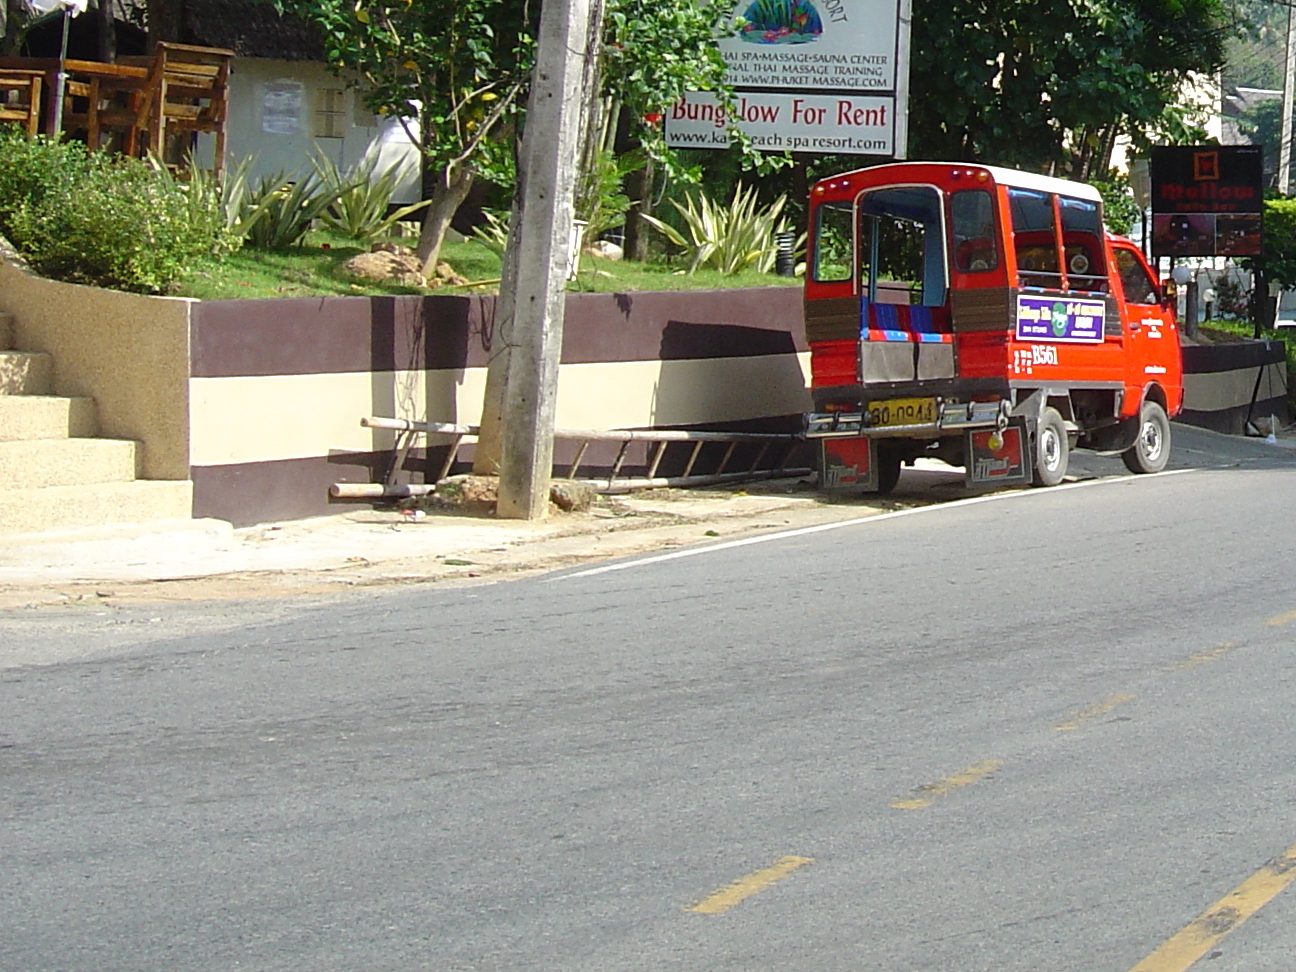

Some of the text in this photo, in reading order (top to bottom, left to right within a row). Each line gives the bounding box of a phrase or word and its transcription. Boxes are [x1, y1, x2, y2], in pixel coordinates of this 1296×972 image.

[722, 52, 738, 60] HAI
[850, 55, 888, 65] CENTER
[754, 64, 777, 73] THAI
[782, 65, 829, 75] MASSAGE
[834, 66, 883, 77] TRAINING
[671, 98, 887, 128] Bunglow For Rent
[1031, 345, 1058, 365] B561
